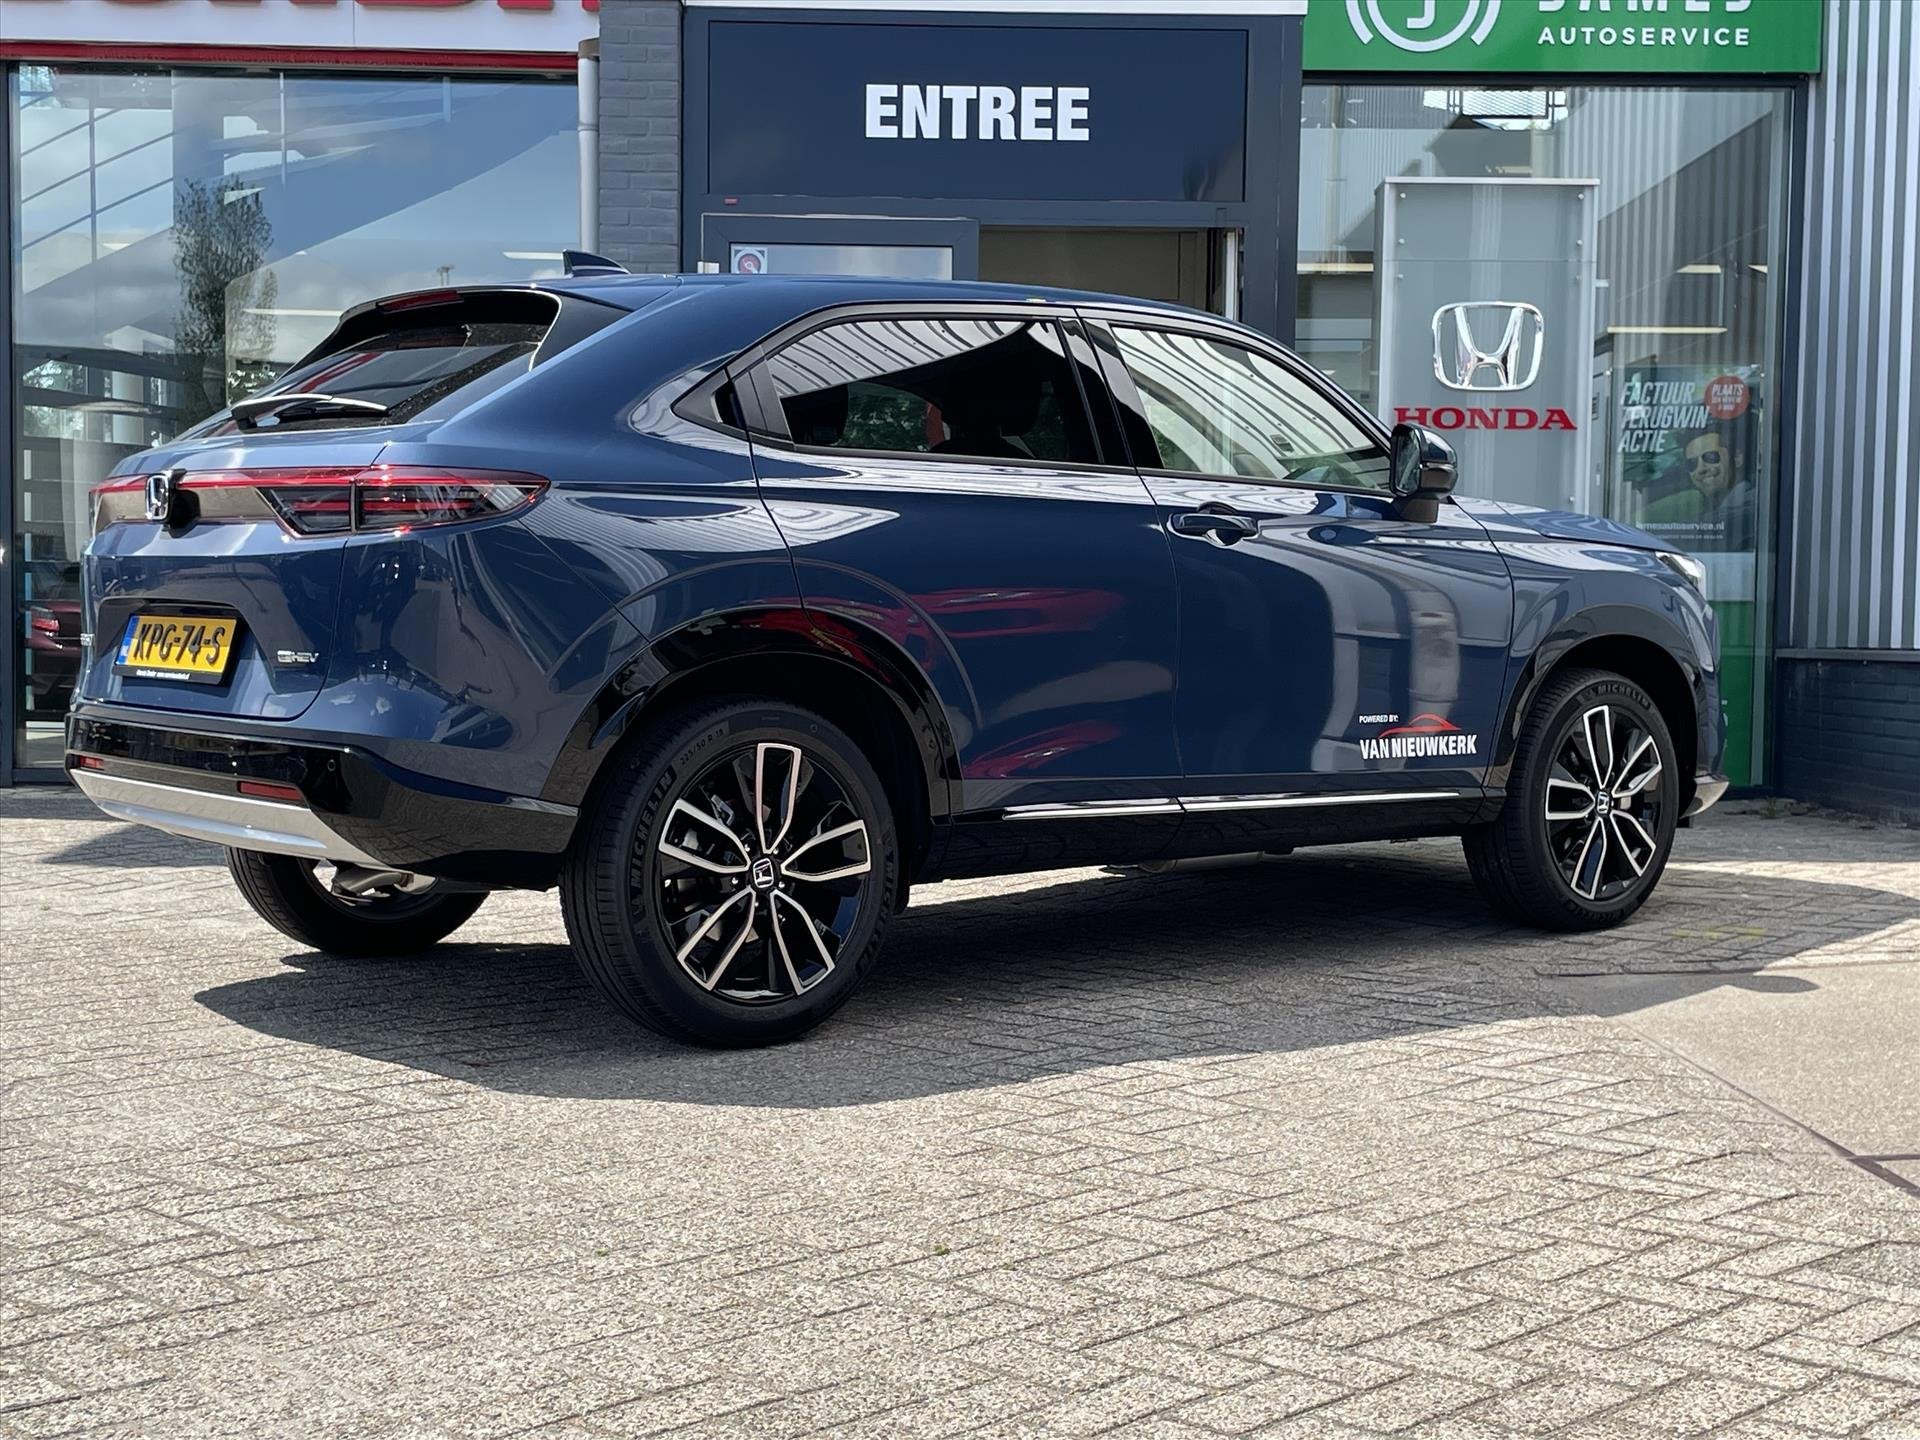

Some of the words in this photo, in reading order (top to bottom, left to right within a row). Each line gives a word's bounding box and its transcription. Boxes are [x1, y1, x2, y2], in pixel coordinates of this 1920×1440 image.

[1538, 27, 1749, 45] AUTOSERVICE
[866, 84, 1089, 141] ENTREE
[1620, 381, 1695, 405] FACTUUR
[1394, 407, 1577, 430] HONDA
[1621, 405, 1710, 428] TERUGWIN
[1617, 430, 1668, 452] ACTIE
[133, 624, 225, 666] KPG-74-S
[1359, 714, 1388, 723] POWERED
[1360, 739, 1389, 759] VAN
[1392, 735, 1477, 758] NIEUWKERK
[631, 771, 673, 889] MICHELIN
